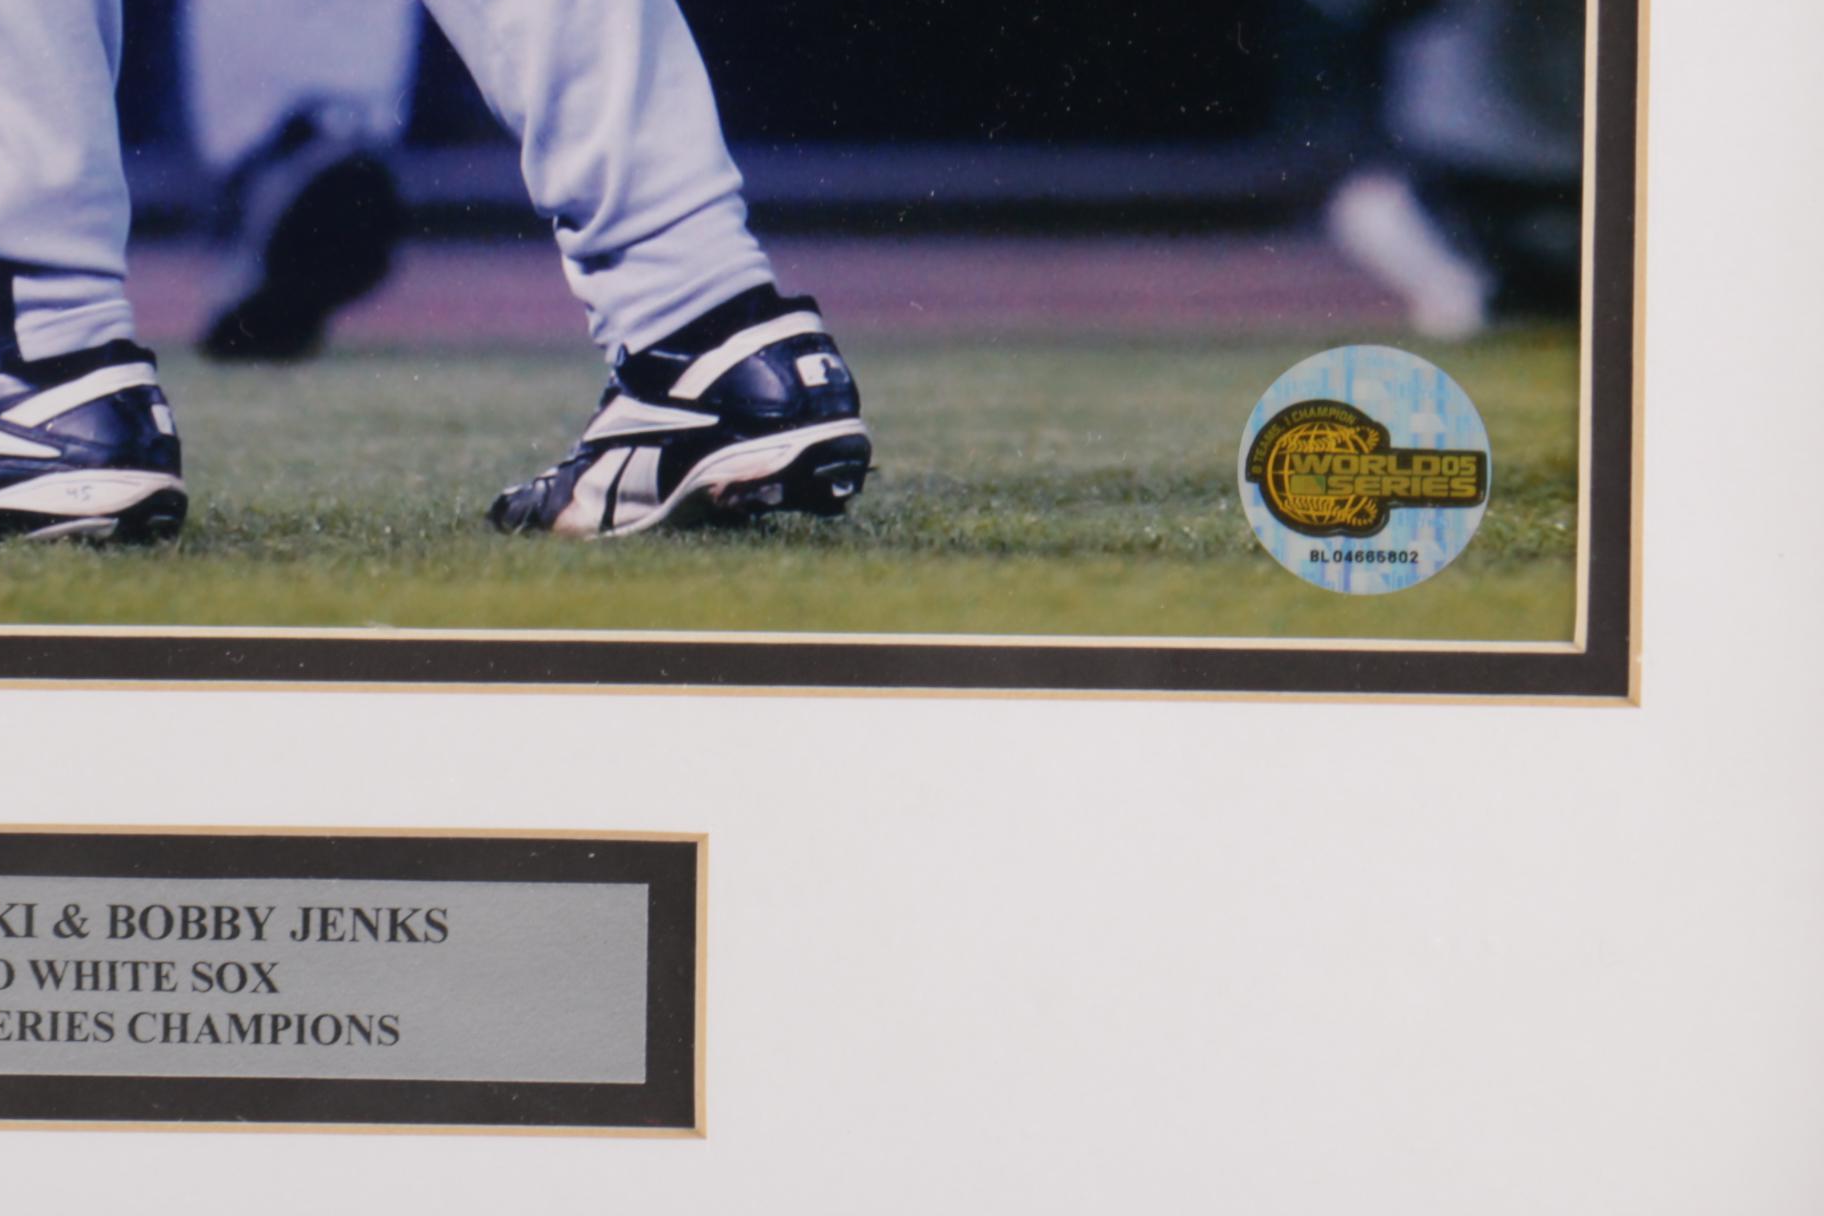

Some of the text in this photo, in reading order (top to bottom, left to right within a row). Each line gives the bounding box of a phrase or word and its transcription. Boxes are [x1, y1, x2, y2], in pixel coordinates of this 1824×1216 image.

[1291, 453, 1476, 476] WORLD 05
[1327, 475, 1477, 498] SERIES
[52, 903, 91, 939] &
[106, 903, 277, 941] BOBBY
[289, 906, 450, 944] JENKS
[29, 959, 179, 992] WHITE
[190, 960, 281, 995] SOX
[127, 1011, 402, 1047] CHAMPIONS
